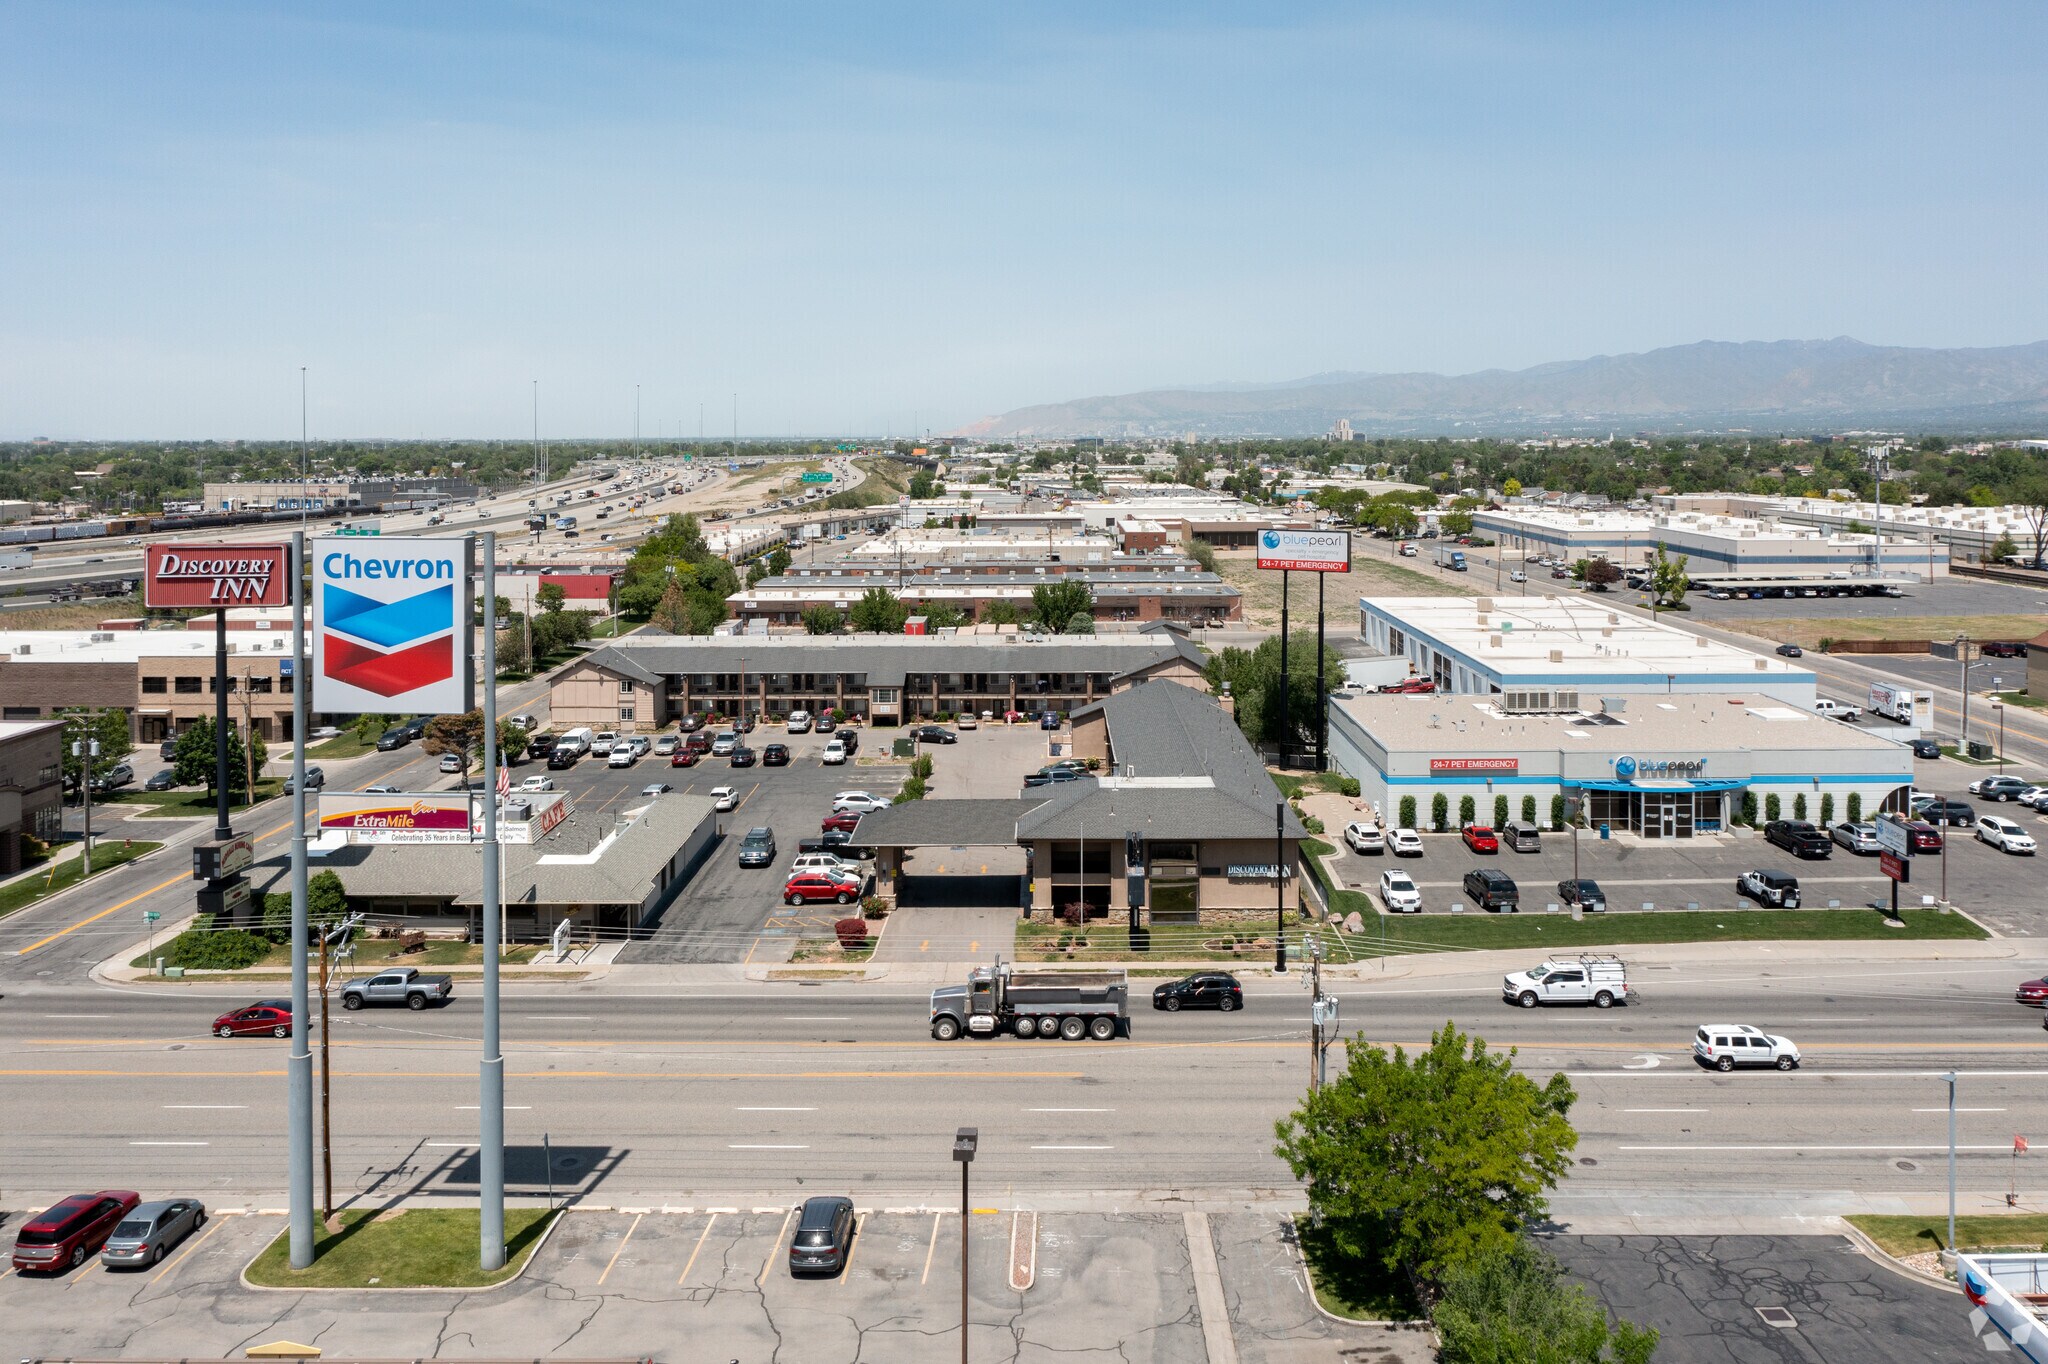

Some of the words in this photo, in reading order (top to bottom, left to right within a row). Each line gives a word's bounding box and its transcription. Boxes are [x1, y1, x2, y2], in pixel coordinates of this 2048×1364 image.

[1283, 534, 1342, 546] bluepearl
[323, 552, 454, 579] Chevron
[209, 578, 269, 598] INN
[354, 814, 414, 828] ExtraMile
[541, 801, 564, 832] CAFE
[1228, 865, 1268, 874] DISCOVERY
